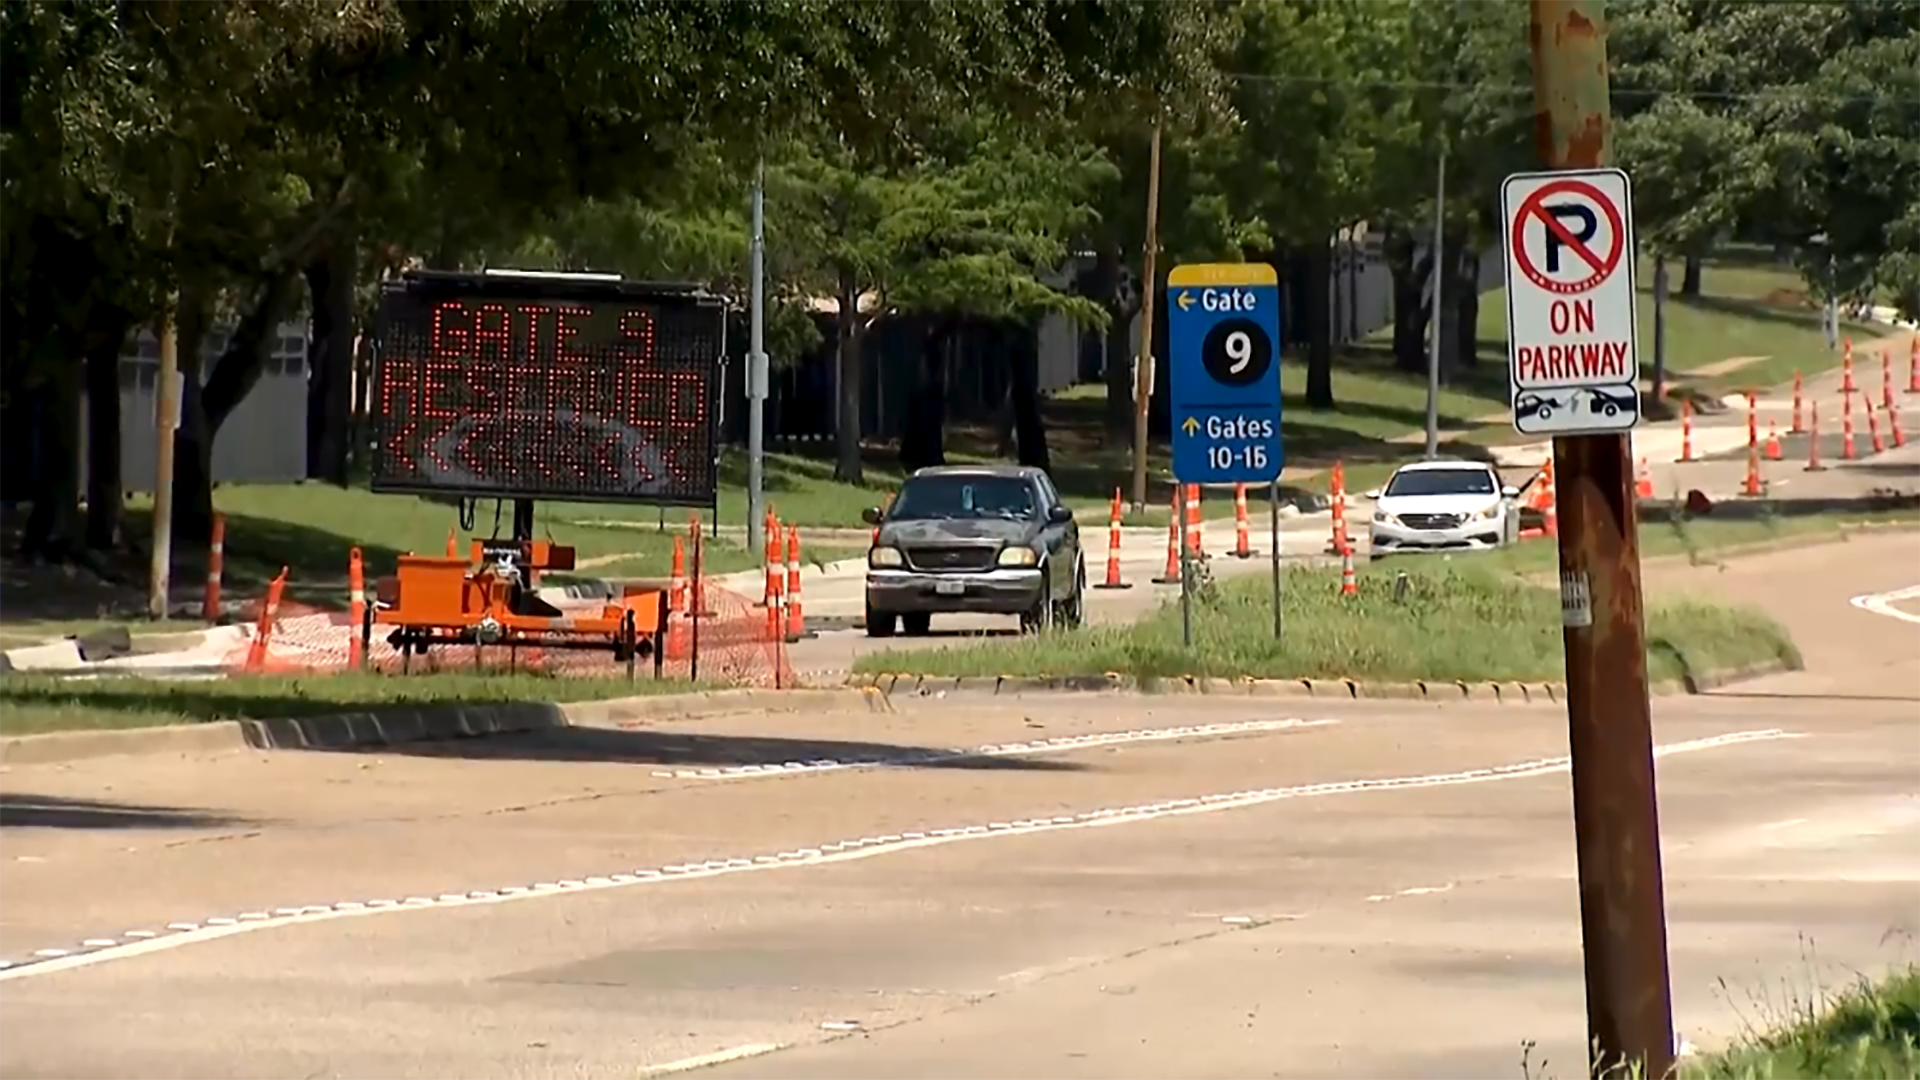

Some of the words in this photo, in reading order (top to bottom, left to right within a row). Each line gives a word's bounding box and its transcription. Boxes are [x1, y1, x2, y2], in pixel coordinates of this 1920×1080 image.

[1202, 288, 1257, 311] Gate
[1550, 299, 1595, 335] ON
[431, 302, 592, 361] GATE
[619, 310, 654, 365] 9
[1225, 331, 1252, 374] 9
[1518, 341, 1628, 381] PARKWAY
[382, 360, 705, 428] RESERVED
[1207, 415, 1273, 439] Gates
